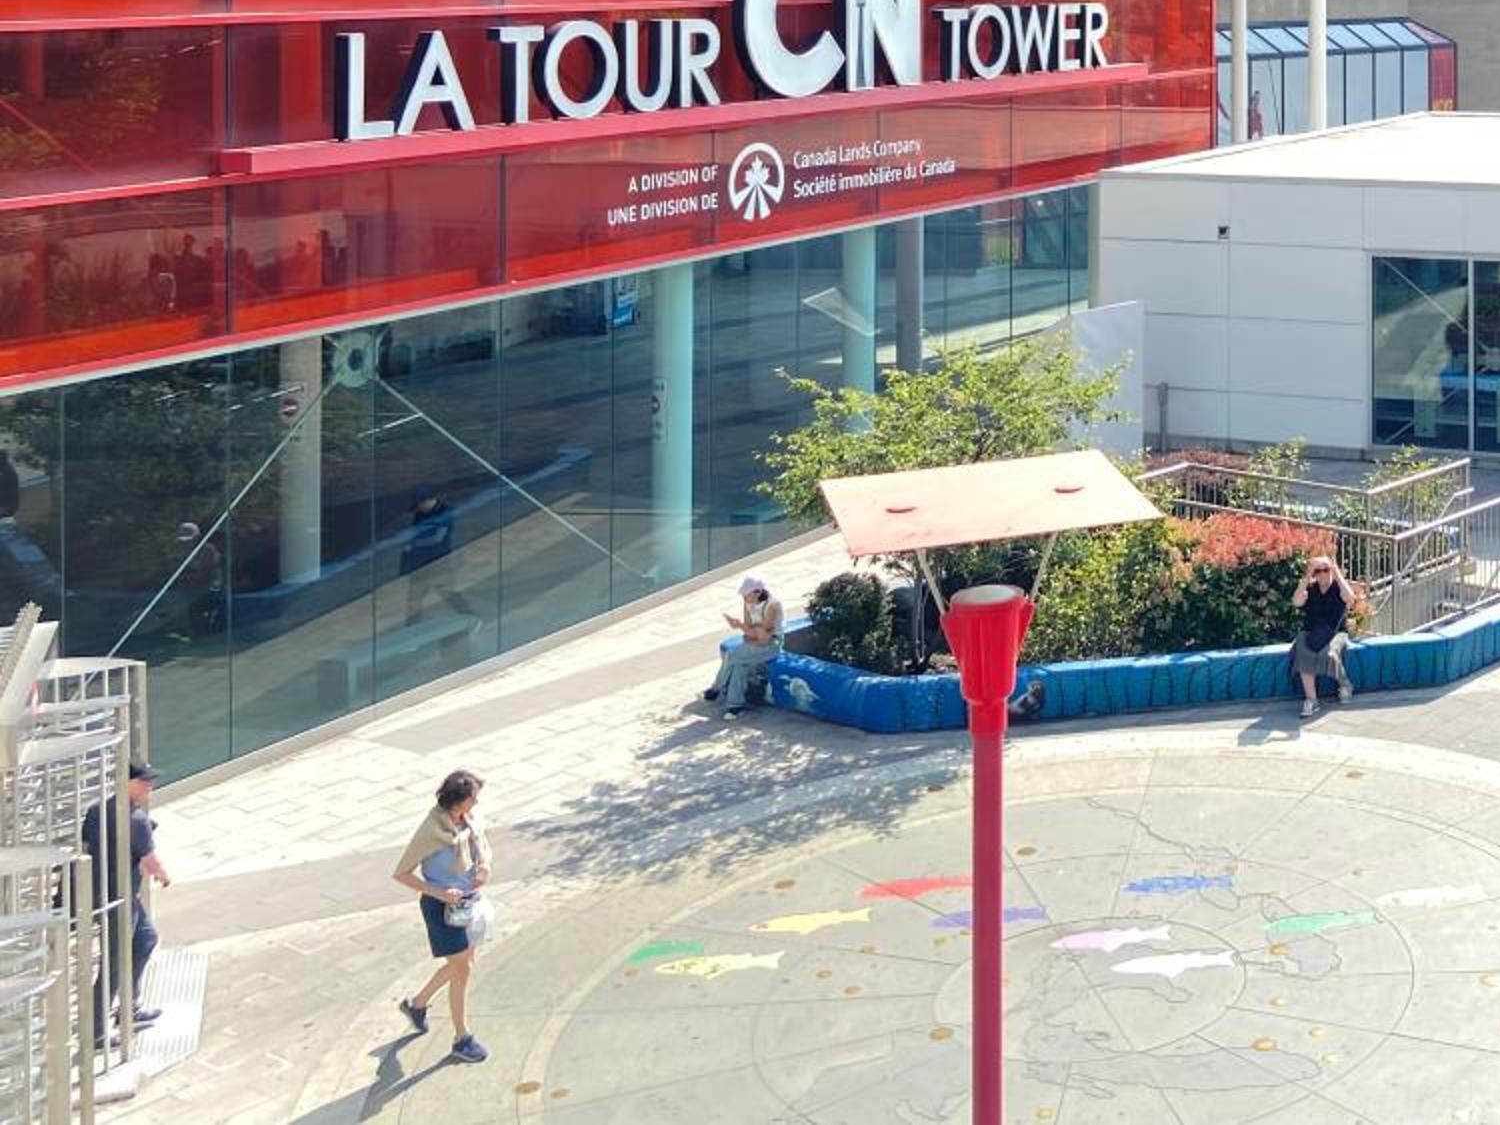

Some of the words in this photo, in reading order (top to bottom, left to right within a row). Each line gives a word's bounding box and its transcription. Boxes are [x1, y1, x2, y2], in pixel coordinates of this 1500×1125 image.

[336, 29, 475, 141] LA
[490, 18, 721, 124] TOUR
[937, 1, 1110, 83] TOWER
[793, 147, 838, 170] Canada
[840, 143, 872, 166] Lands
[874, 138, 922, 162] Company
[628, 177, 639, 194] A
[641, 170, 698, 192] DIVISION
[701, 166, 719, 182] OF
[793, 172, 837, 199] Société
[839, 165, 903, 192] immobilière
[904, 164, 918, 182] du
[919, 157, 956, 177] Canada
[607, 205, 637, 225] UNE
[641, 198, 698, 222] DIVISION
[701, 192, 719, 210] DE
